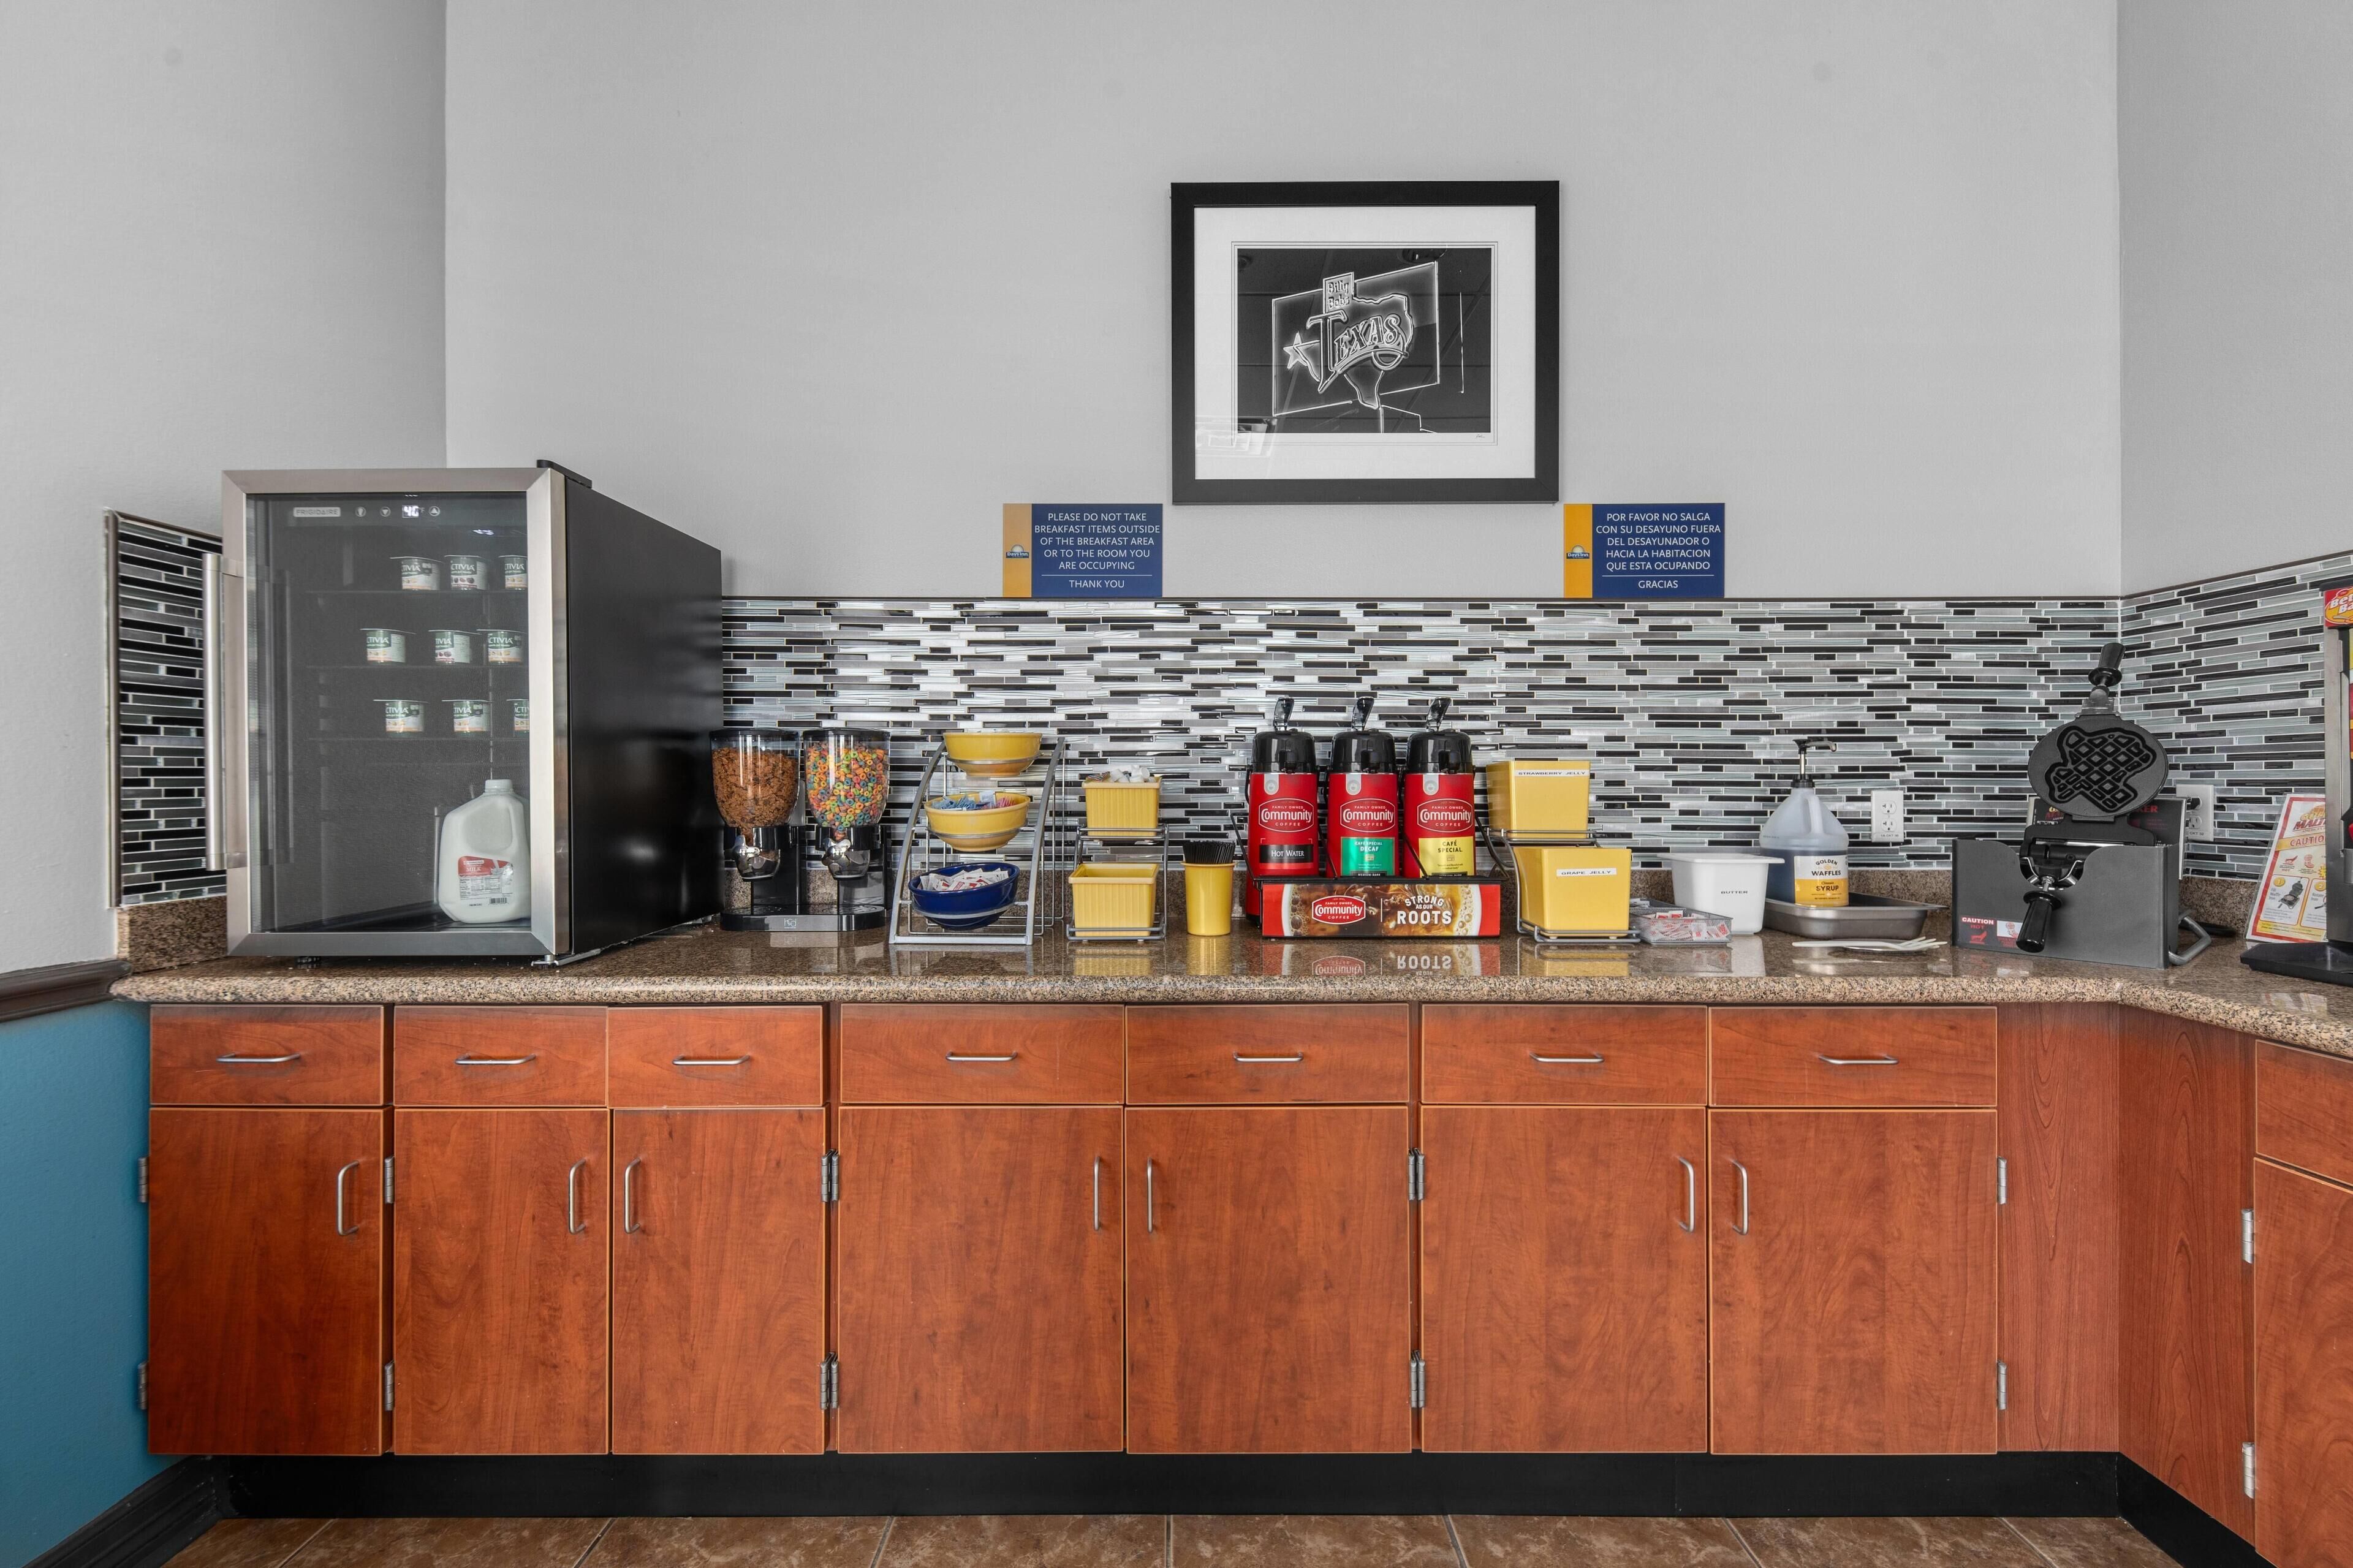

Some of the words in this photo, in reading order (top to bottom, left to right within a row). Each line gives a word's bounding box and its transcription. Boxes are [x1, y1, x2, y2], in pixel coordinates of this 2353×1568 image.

[1101, 513, 1122, 521] NOT
[1123, 513, 1147, 521] TAKE
[1607, 513, 1626, 521] POR
[1629, 513, 1660, 521] FAVOR
[1680, 512, 1711, 521] SALGA
[1034, 525, 1086, 533] BREAKFAST
[1088, 525, 1116, 534] ITEMS
[1118, 525, 1161, 534] OUTSIDE
[1596, 525, 1618, 534] CON
[1620, 525, 1633, 534] SU
[1635, 525, 1688, 534] DESAYUNO
[1691, 525, 1721, 533] FUERA
[1040, 537, 1053, 545] OF
[1055, 537, 1074, 545] THE
[1077, 537, 1129, 545] BREAKFAST
[1130, 537, 1154, 545] AREA
[1607, 537, 1626, 546] DEL
[1627, 537, 1699, 546] DESAYUNADOR
[1702, 537, 1710, 545] O
[1044, 549, 1058, 558] OR
[1059, 549, 1074, 558] TO
[1075, 549, 1094, 558] THE
[1097, 549, 1127, 558] ROOM
[1129, 549, 1150, 558] YOU
[1606, 550, 1635, 558] HACIA
[1638, 549, 1650, 558] LA
[1651, 549, 1710, 558] HABITACION
[1058, 561, 1077, 570] ARE
[1078, 561, 1135, 570] OCCUPYING
[1606, 562, 1627, 572] QUE
[1629, 561, 1653, 570] ESTA
[1654, 561, 1710, 570] OCUPANDO
[1069, 580, 1102, 588] THANK
[1104, 580, 1124, 588] YOU
[1638, 580, 1678, 589] GRACIAS
[1261, 808, 1312, 823] Community
[1343, 808, 1394, 823] Community
[1420, 809, 1471, 823] Community
[2290, 835, 2324, 847] CAUTIO
[1404, 895, 1444, 906] STRONG
[1315, 904, 1363, 916] Community
[1397, 911, 1452, 925] ROOTS
